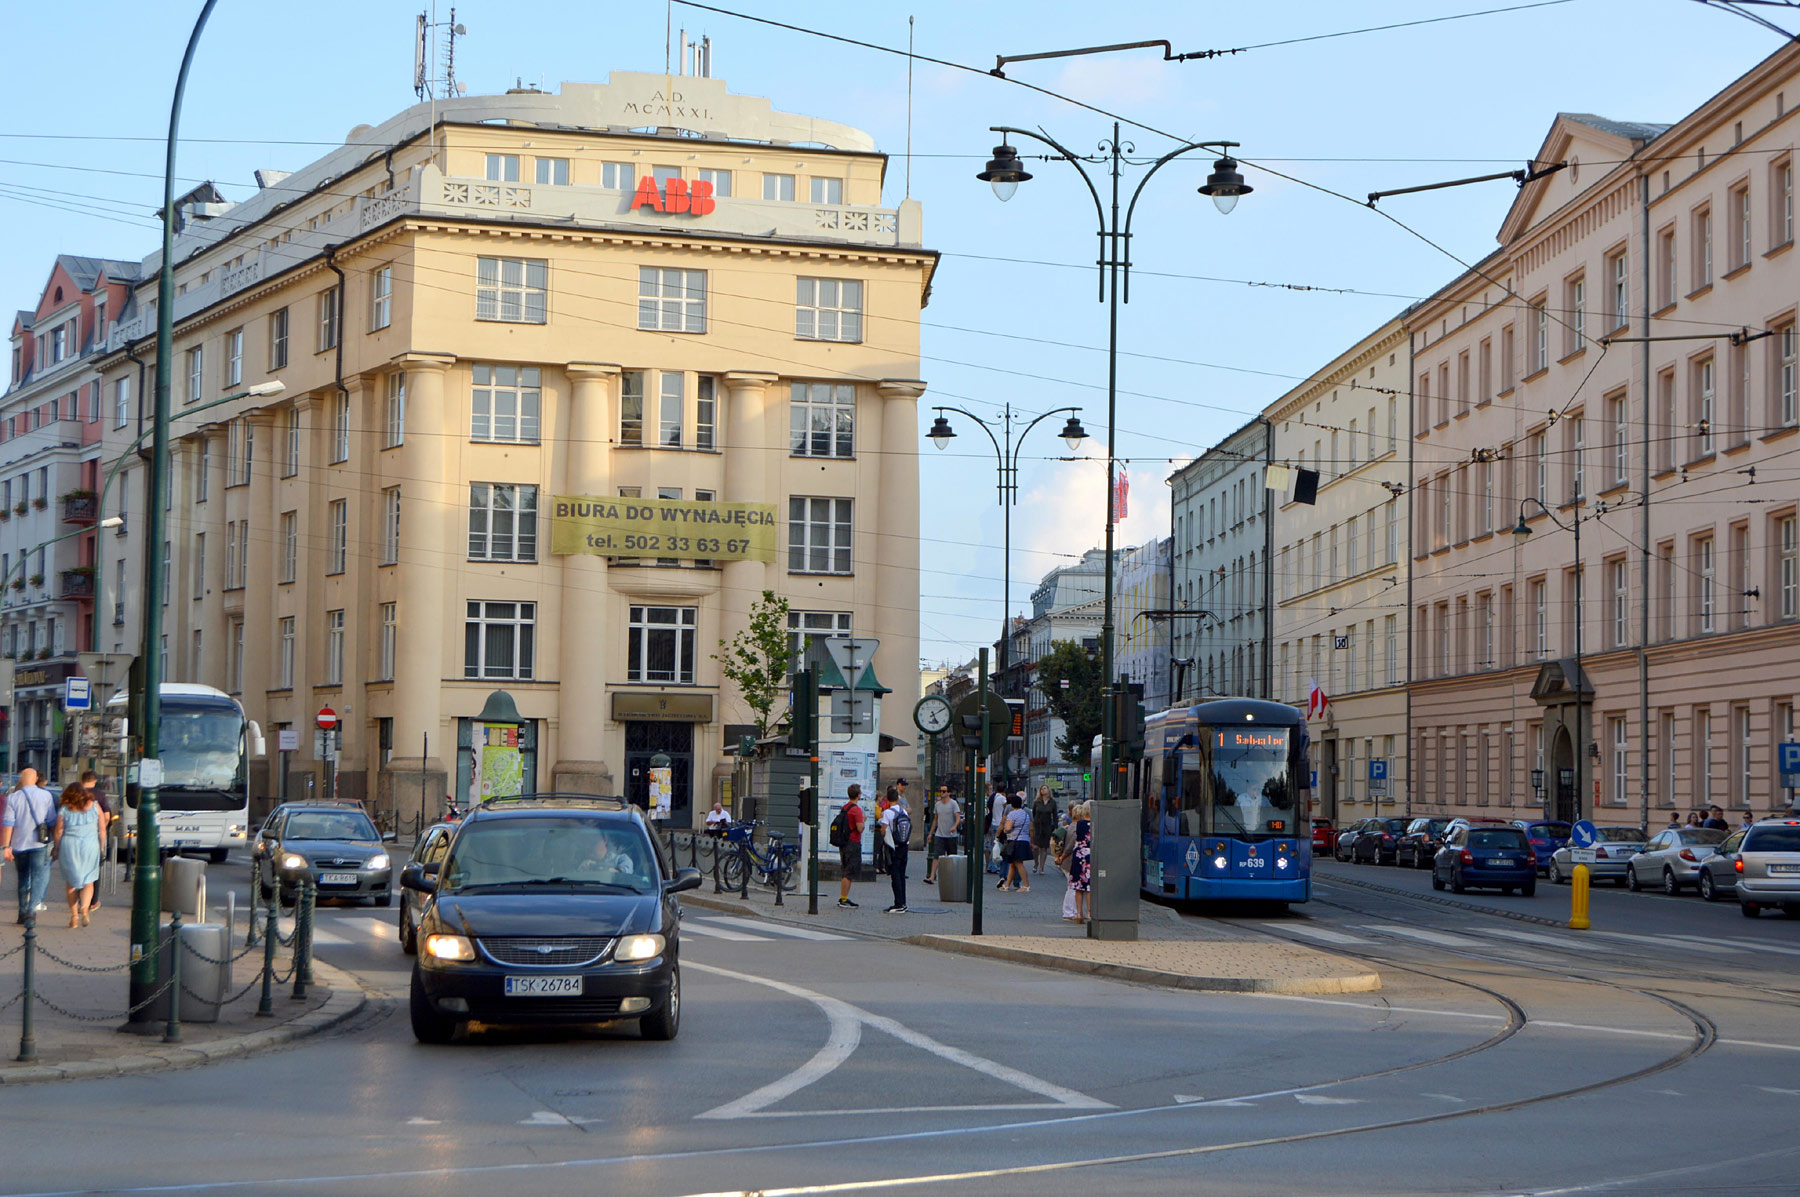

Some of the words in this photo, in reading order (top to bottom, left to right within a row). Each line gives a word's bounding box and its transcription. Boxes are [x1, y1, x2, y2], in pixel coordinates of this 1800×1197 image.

[652, 90, 686, 103] A.D.
[623, 102, 713, 120] MCMXXI.
[630, 175, 716, 215] ABB
[556, 502, 620, 520] BIURA
[626, 505, 654, 521] DO
[660, 507, 775, 528] WYNAJĘCIA
[586, 533, 618, 549] tel.
[624, 535, 660, 551] 502
[666, 536, 690, 551] 33
[696, 537, 721, 553] 63
[726, 538, 751, 554] 67
[1218, 732, 1224, 747] 1
[1786, 746, 1800, 769] P
[1373, 763, 1383, 776] P
[1247, 858, 1264, 868] 639
[513, 978, 536, 992] TSK
[541, 978, 579, 992] 26784
